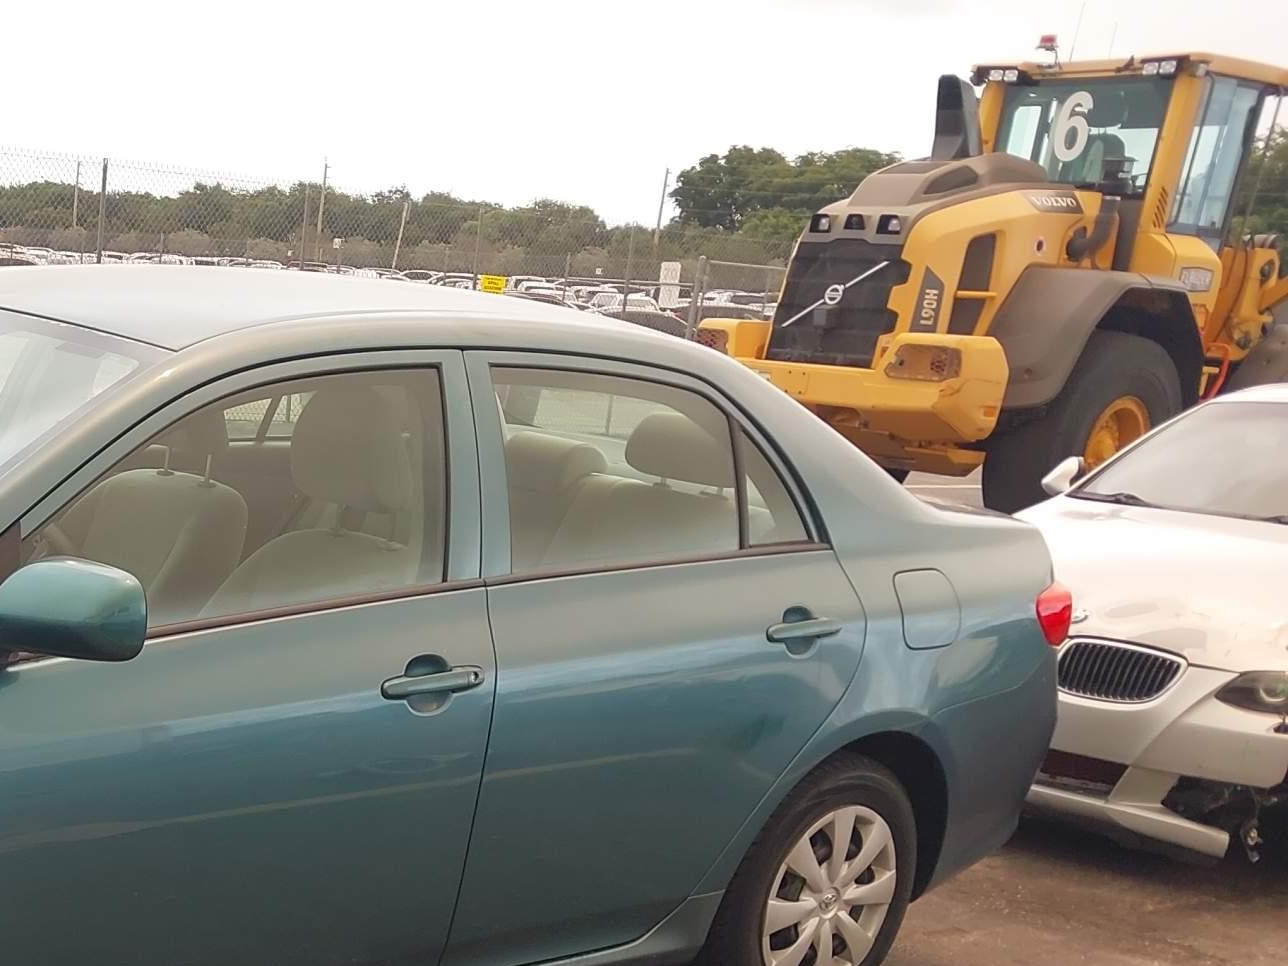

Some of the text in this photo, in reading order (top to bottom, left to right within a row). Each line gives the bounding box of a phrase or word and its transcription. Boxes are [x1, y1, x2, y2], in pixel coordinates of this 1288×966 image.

[1054, 91, 1094, 162] 6
[1031, 195, 1077, 208] VOLVO
[919, 289, 939, 326] L90H
